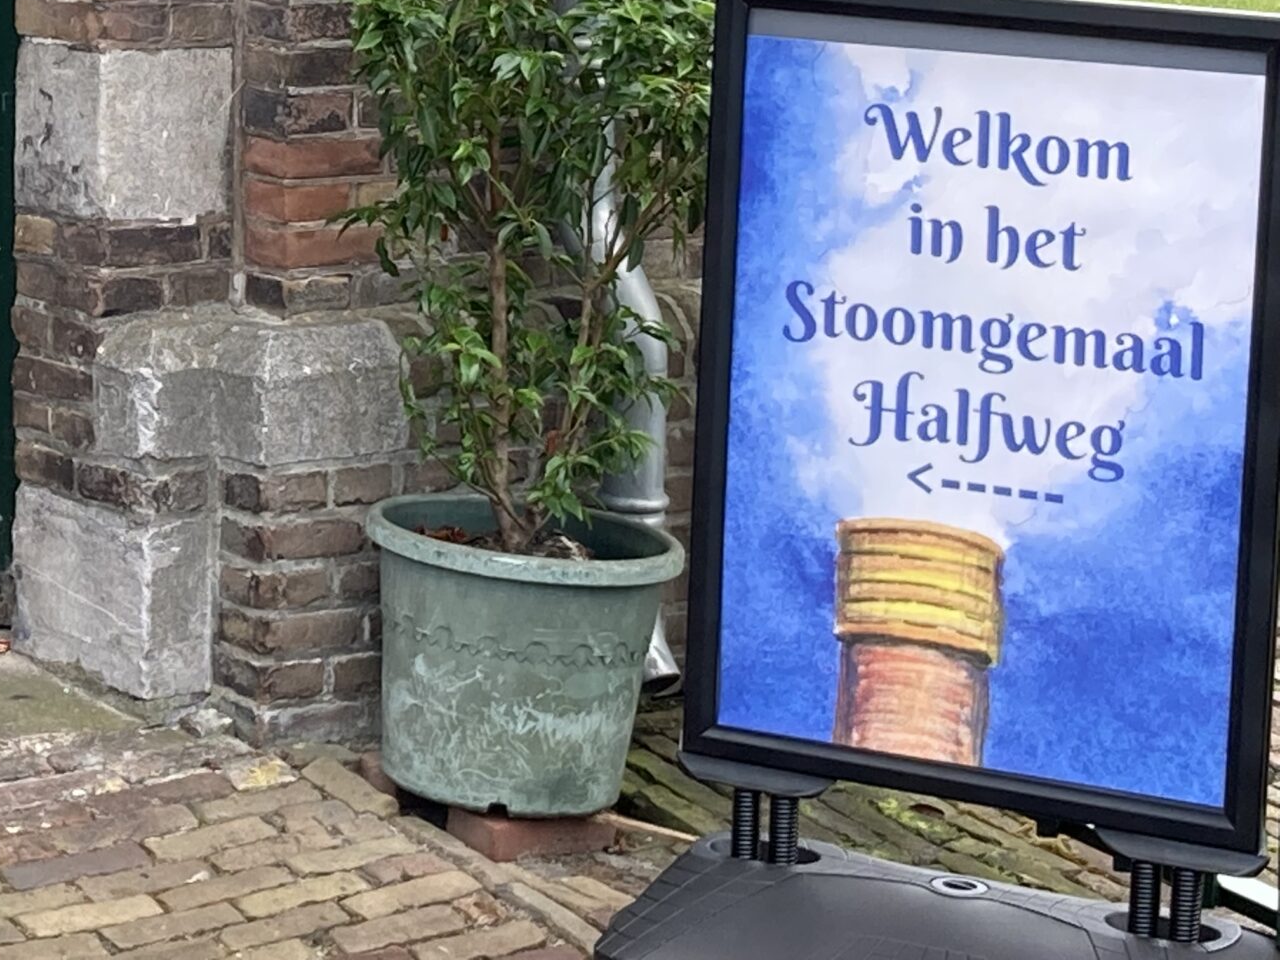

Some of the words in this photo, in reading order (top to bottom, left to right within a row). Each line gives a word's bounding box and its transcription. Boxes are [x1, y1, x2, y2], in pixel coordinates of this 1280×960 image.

[864, 103, 1132, 186] Welkom
[907, 203, 963, 263] in
[984, 205, 1087, 271] het
[782, 280, 1205, 381] Stoomgemaal
[849, 371, 1126, 482] Halfweg
